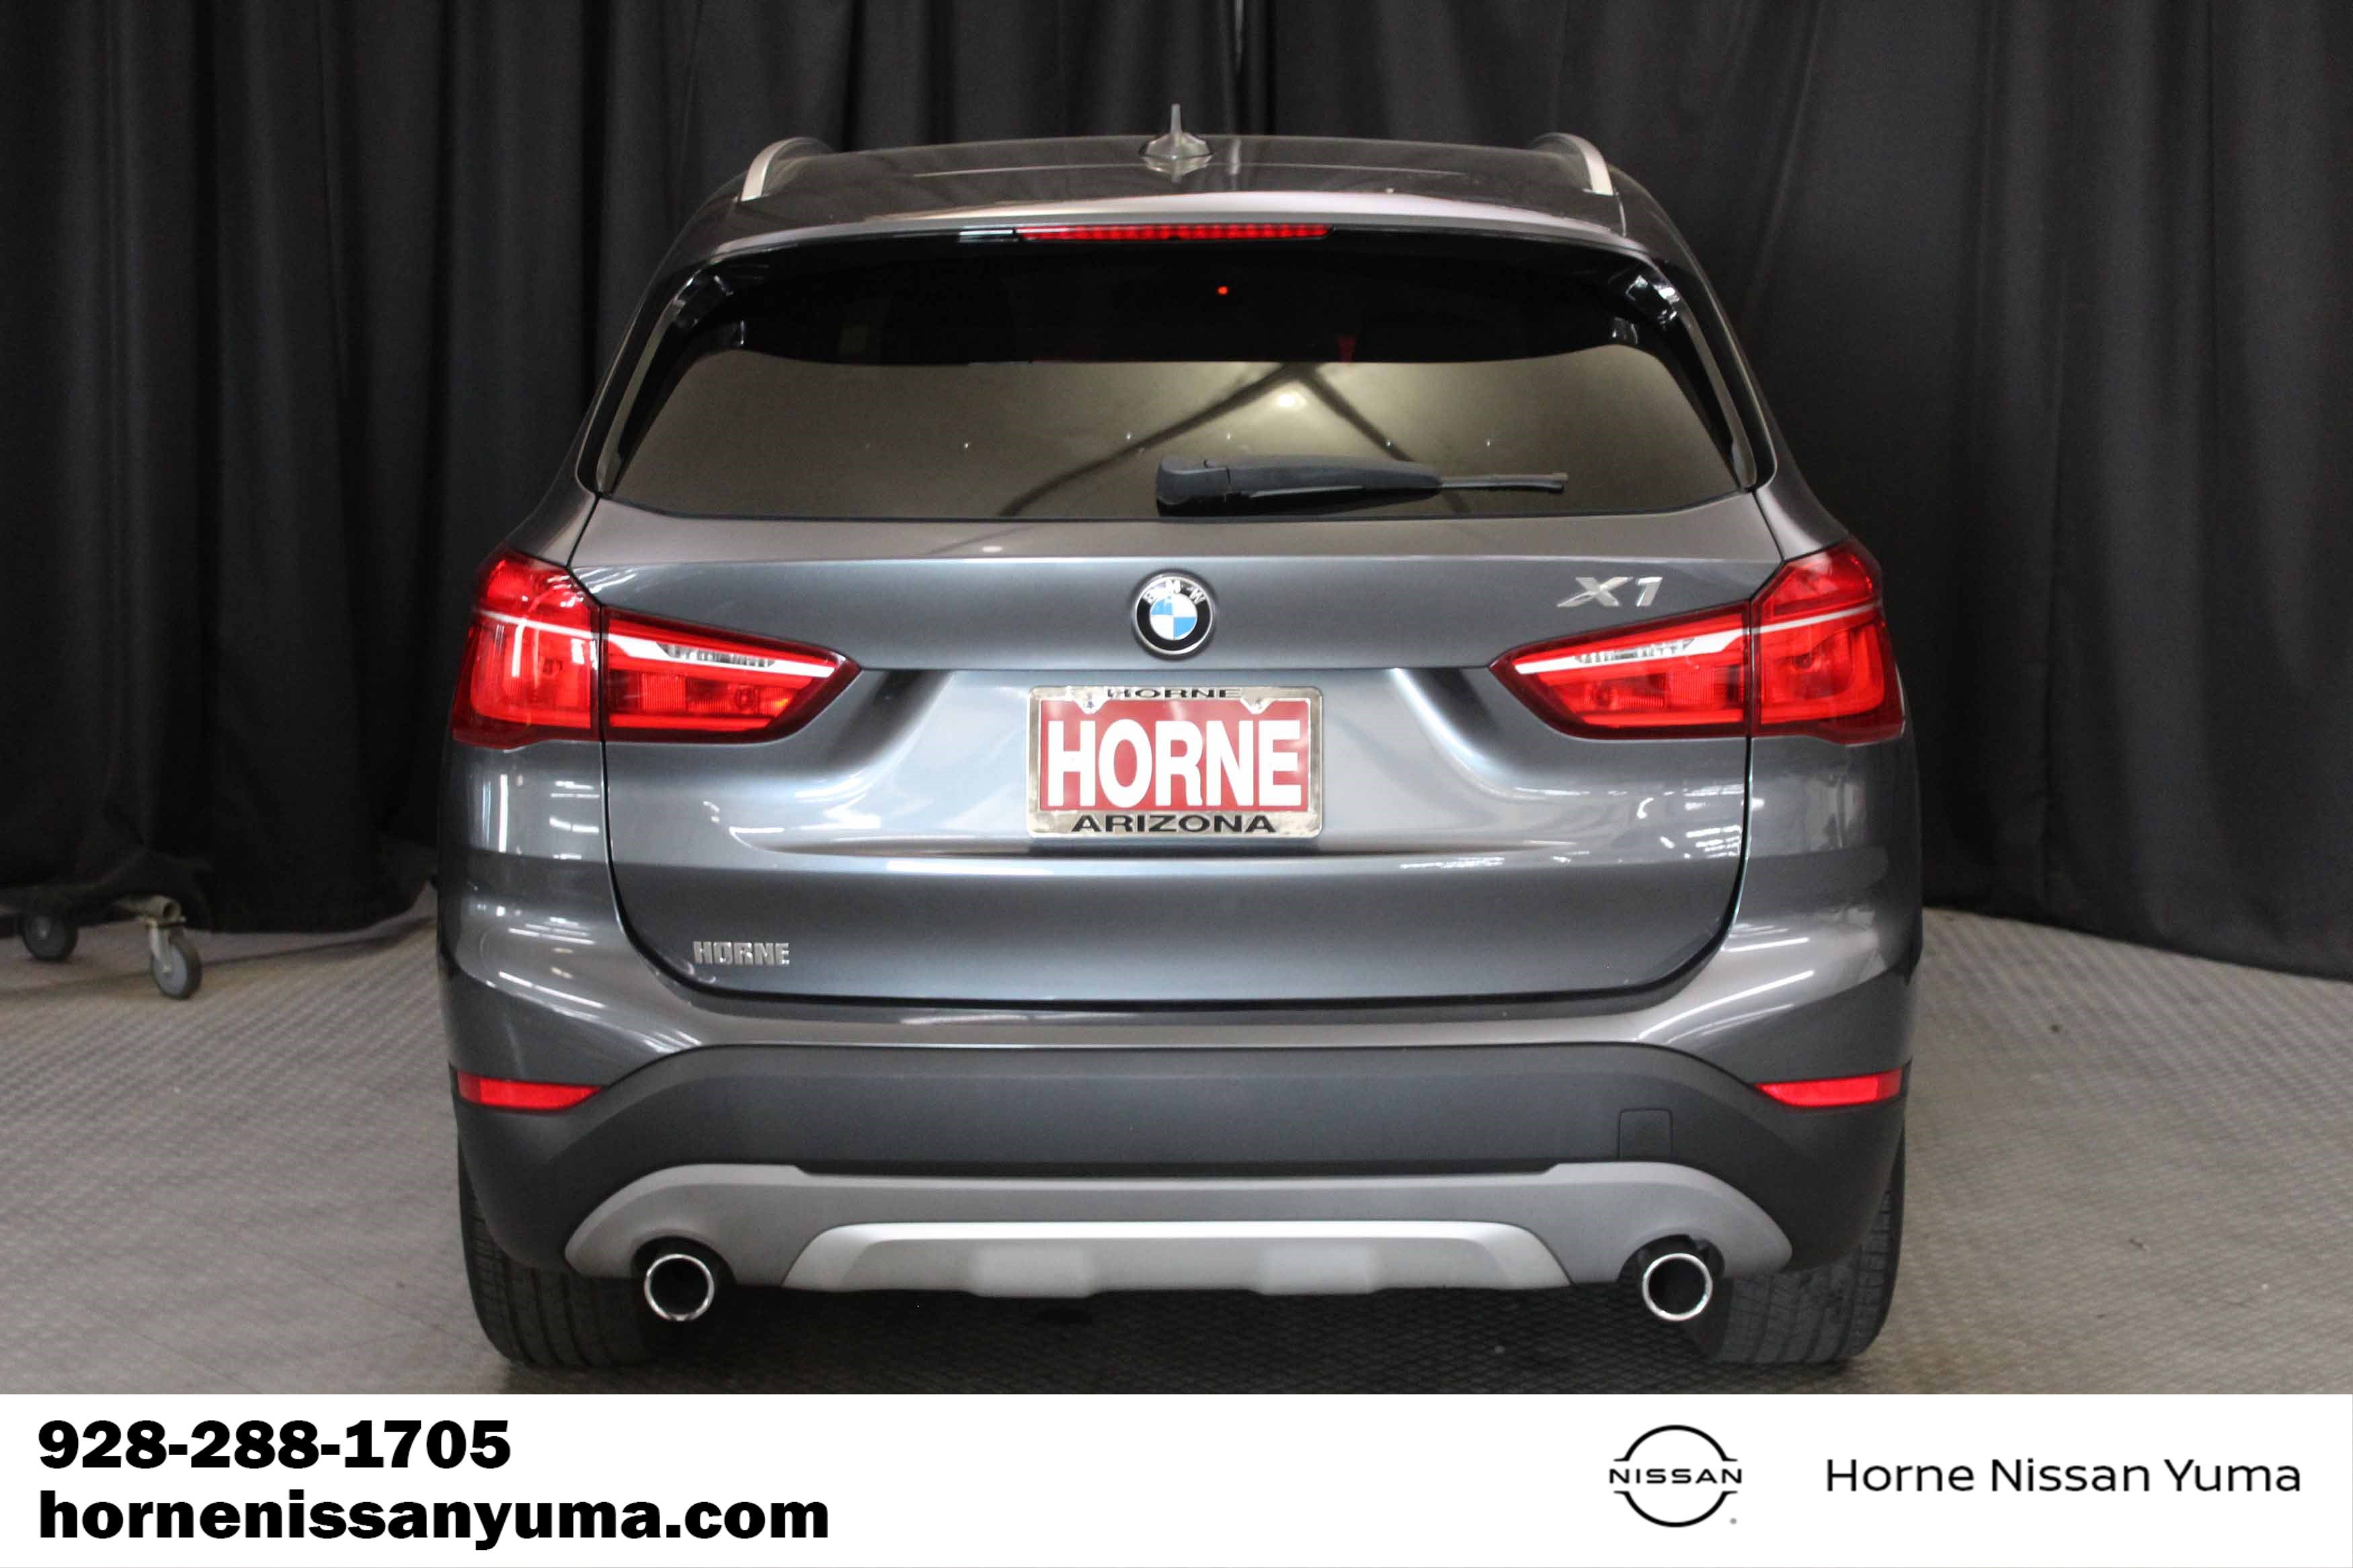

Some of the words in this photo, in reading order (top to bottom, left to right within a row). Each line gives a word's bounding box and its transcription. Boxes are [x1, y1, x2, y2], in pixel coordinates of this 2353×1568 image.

[1143, 579, 1205, 604] BMW
[1556, 577, 1663, 607] X1
[1107, 688, 1242, 699] HORNE
[1047, 718, 1302, 807] HORNE
[1071, 815, 1277, 833] ARIZONA
[693, 942, 790, 965] HORNE
